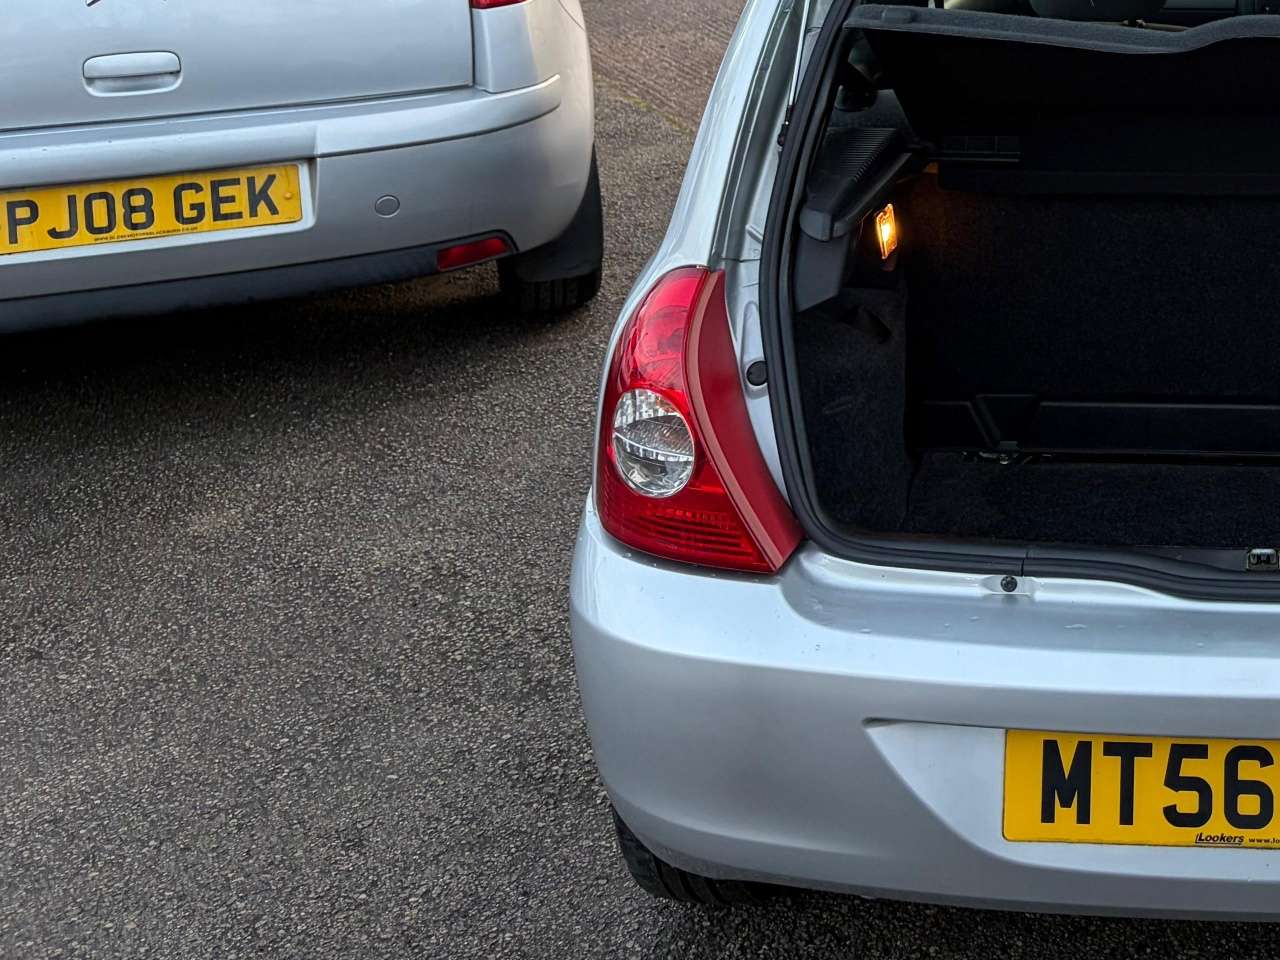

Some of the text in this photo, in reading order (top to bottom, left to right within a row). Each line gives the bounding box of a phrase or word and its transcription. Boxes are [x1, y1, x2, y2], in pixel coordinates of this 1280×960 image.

[6, 174, 280, 244] PJ08 GEK
[1041, 739, 1274, 830] MT56
[1196, 831, 1244, 845] Lookers
